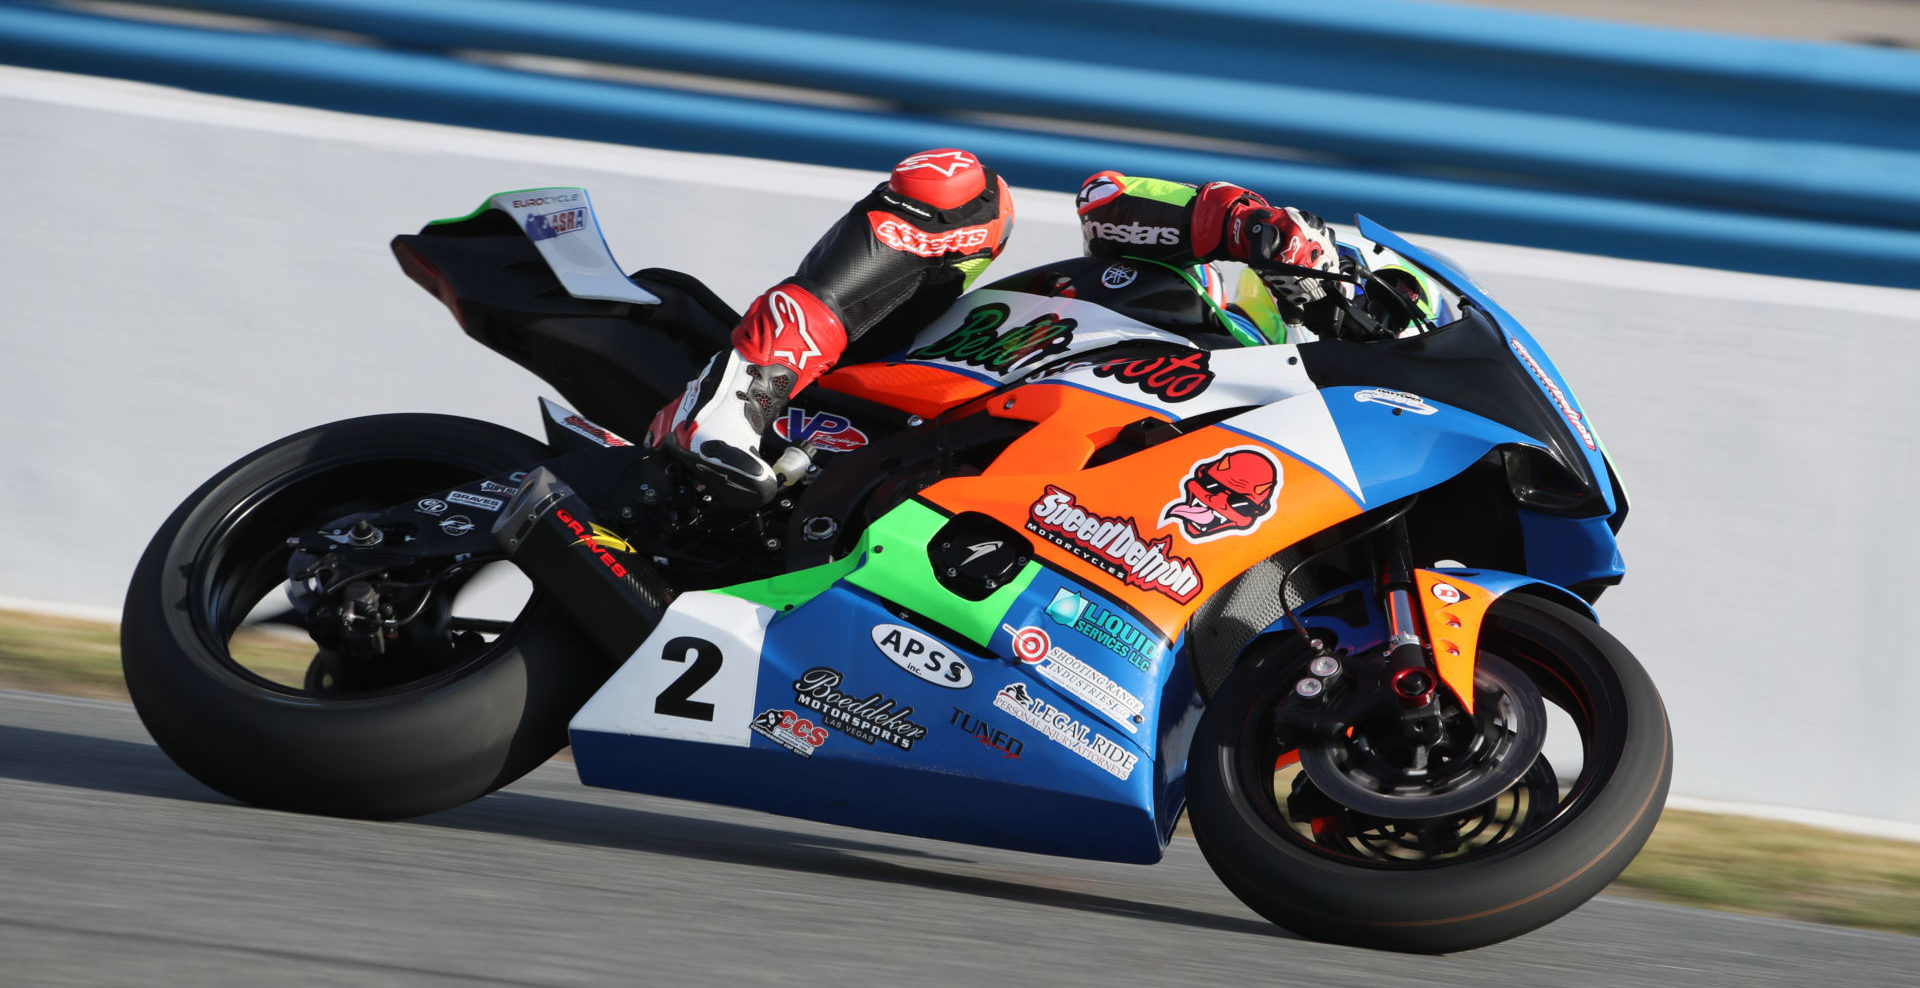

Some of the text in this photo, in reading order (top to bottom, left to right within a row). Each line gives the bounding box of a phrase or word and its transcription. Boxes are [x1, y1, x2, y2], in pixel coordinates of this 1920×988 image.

[512, 193, 579, 208] EUROCYCLE
[552, 209, 584, 232] ASRA
[788, 411, 852, 443] VP
[452, 492, 500, 507] GRAVES
[556, 508, 628, 578] GRAVES
[1026, 522, 1126, 580] MOTORCYCLES
[880, 629, 966, 683] APSS
[1075, 620, 1151, 673] SERVICES LLC
[1083, 602, 1160, 661] LIQUID
[653, 635, 724, 722] 2
[906, 662, 923, 676] inc.
[1048, 662, 1117, 708] INDUSTRIES
[1051, 647, 1107, 685] SHOOTING
[1103, 680, 1142, 711] RANGE
[778, 710, 829, 747] CCS
[795, 668, 926, 739] Boeddeker
[798, 693, 911, 749] MOTORSPORTS
[843, 725, 875, 743] VEGAS
[994, 697, 1043, 730] PERSONAL
[1042, 723, 1075, 749] INJURY
[1073, 744, 1129, 780] ATTORNEYS
[1032, 699, 1091, 746] LEGAL
[1092, 733, 1138, 772] RIDE
